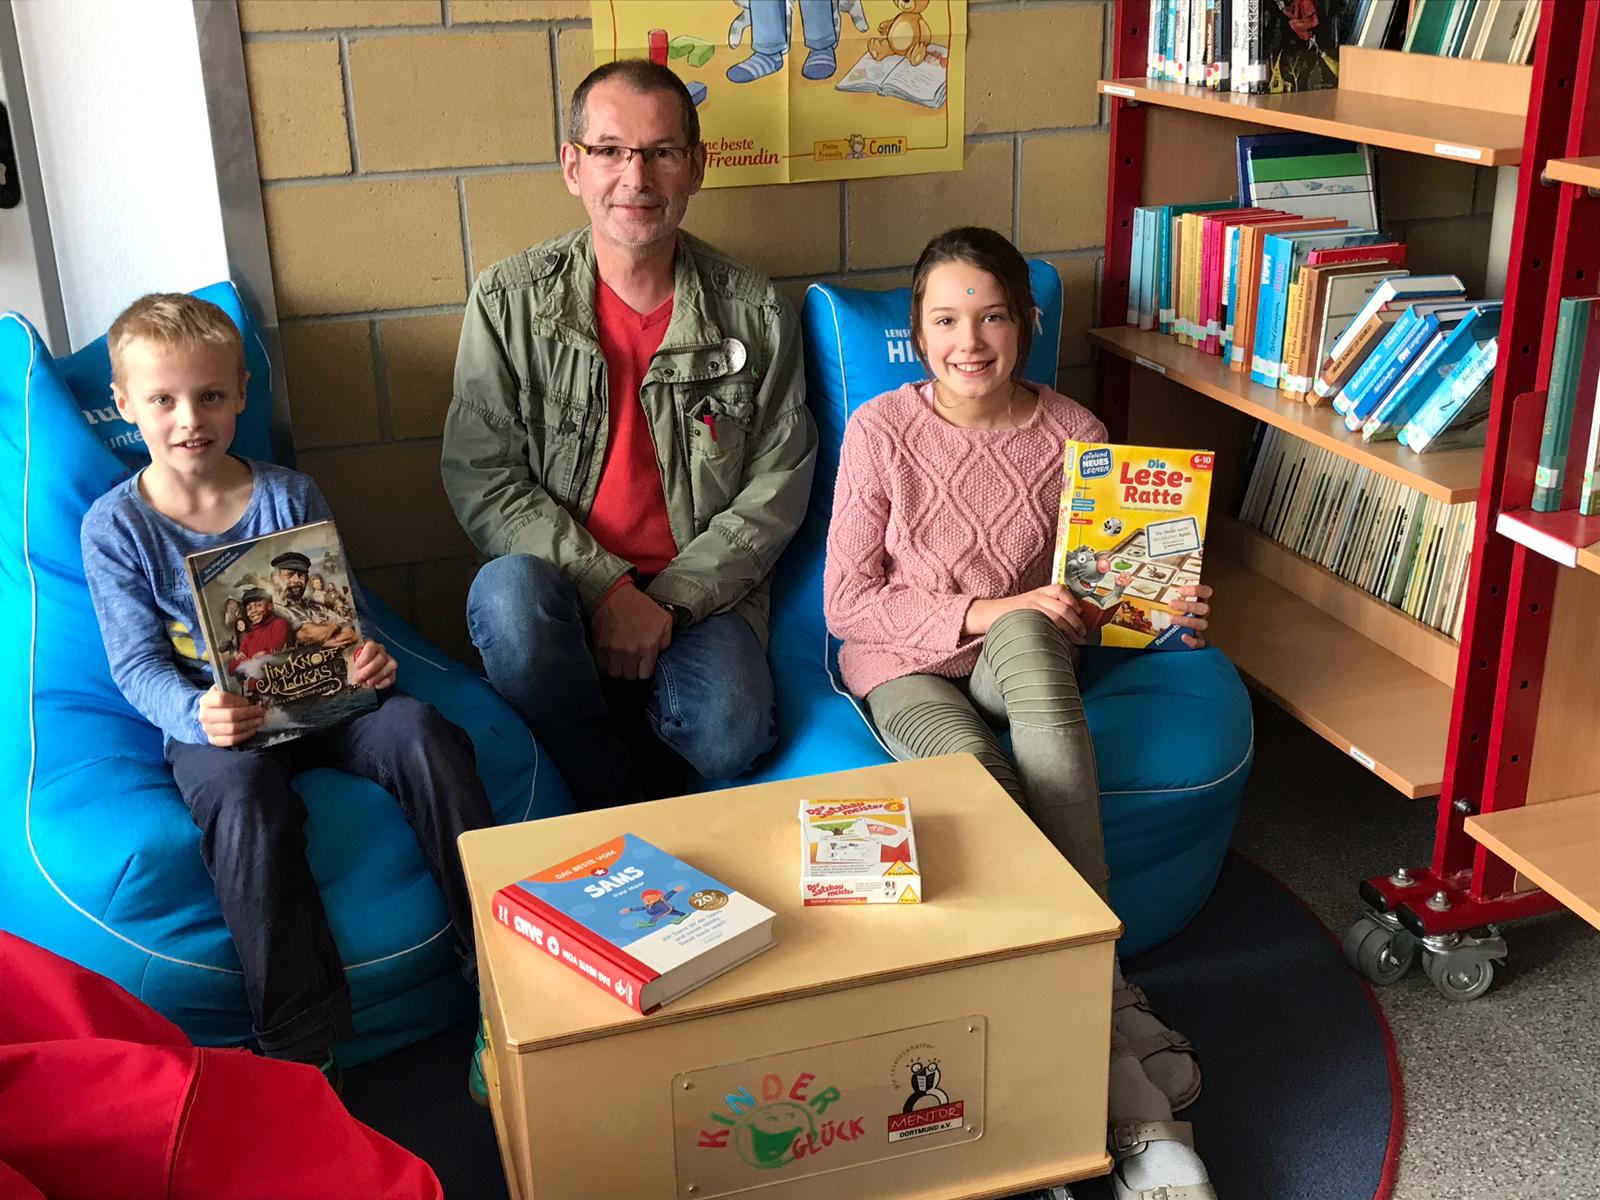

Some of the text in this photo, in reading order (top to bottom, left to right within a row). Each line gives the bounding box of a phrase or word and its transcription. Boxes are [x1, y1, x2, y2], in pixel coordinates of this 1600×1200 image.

[721, 136, 754, 151] beste
[869, 139, 903, 155] Conni
[706, 147, 781, 168] Freundin
[1453, 352, 1473, 379] Madita
[1082, 457, 1110, 469] NEUES
[1147, 459, 1167, 469] Die
[1193, 455, 1212, 465] 6-10
[1082, 465, 1110, 476] LERNEN
[1119, 462, 1193, 488] Lese-
[1123, 485, 1183, 506] Ratte
[287, 646, 340, 674] KNOPF
[279, 665, 333, 692] LUKAS
[806, 805, 826, 816] Der
[815, 802, 866, 819] Satzbau
[841, 803, 885, 817] meister
[555, 849, 618, 880] DAS BESTE VOM
[583, 866, 645, 899] SAMS
[807, 882, 821, 893] Der
[811, 883, 845, 897] Satzbau
[826, 888, 855, 898] meister
[513, 914, 544, 946] SAMS
[561, 948, 579, 966] VOM
[578, 959, 598, 979] BESTE
[597, 971, 611, 988] DAS
[697, 1073, 841, 1148] KINDER
[890, 1107, 960, 1130] MENTOR
[791, 1116, 865, 1160] GLÜCK
[899, 1121, 953, 1139] DORTMUND e.V.
